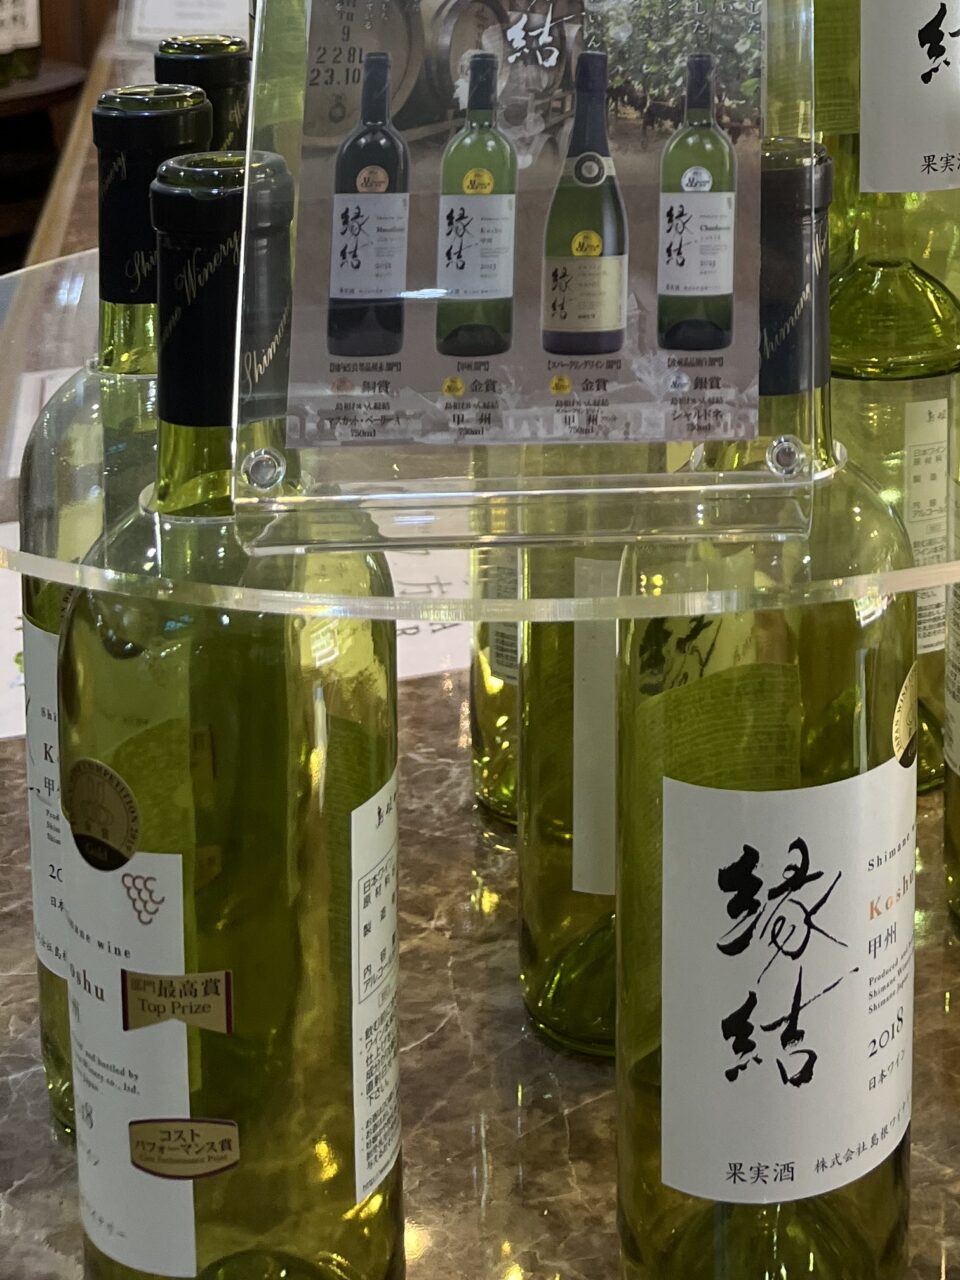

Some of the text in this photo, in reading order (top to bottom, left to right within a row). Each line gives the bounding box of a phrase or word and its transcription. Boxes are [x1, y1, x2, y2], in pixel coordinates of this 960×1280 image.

[175, 226, 242, 306] Winery
[470, 378, 498, 394] 金賞
[581, 377, 610, 392] 金賞
[867, 831, 910, 872] Shimane
[868, 869, 914, 921] Koshu
[97, 940, 132, 959] wine
[868, 922, 897, 961] 甲州
[716, 836, 860, 1090] 縁結
[70, 962, 105, 1002] oshu
[130, 978, 222, 999] 部門最高賞
[137, 997, 212, 1017] Top Prize
[868, 1006, 904, 1058] 2018
[128, 1068, 140, 1082] by
[868, 1049, 905, 1091] 日本ワイン
[135, 1138, 233, 1157] パフォーマンス賞
[159, 1128, 201, 1144] コスト
[725, 1160, 796, 1185] 果実酒
